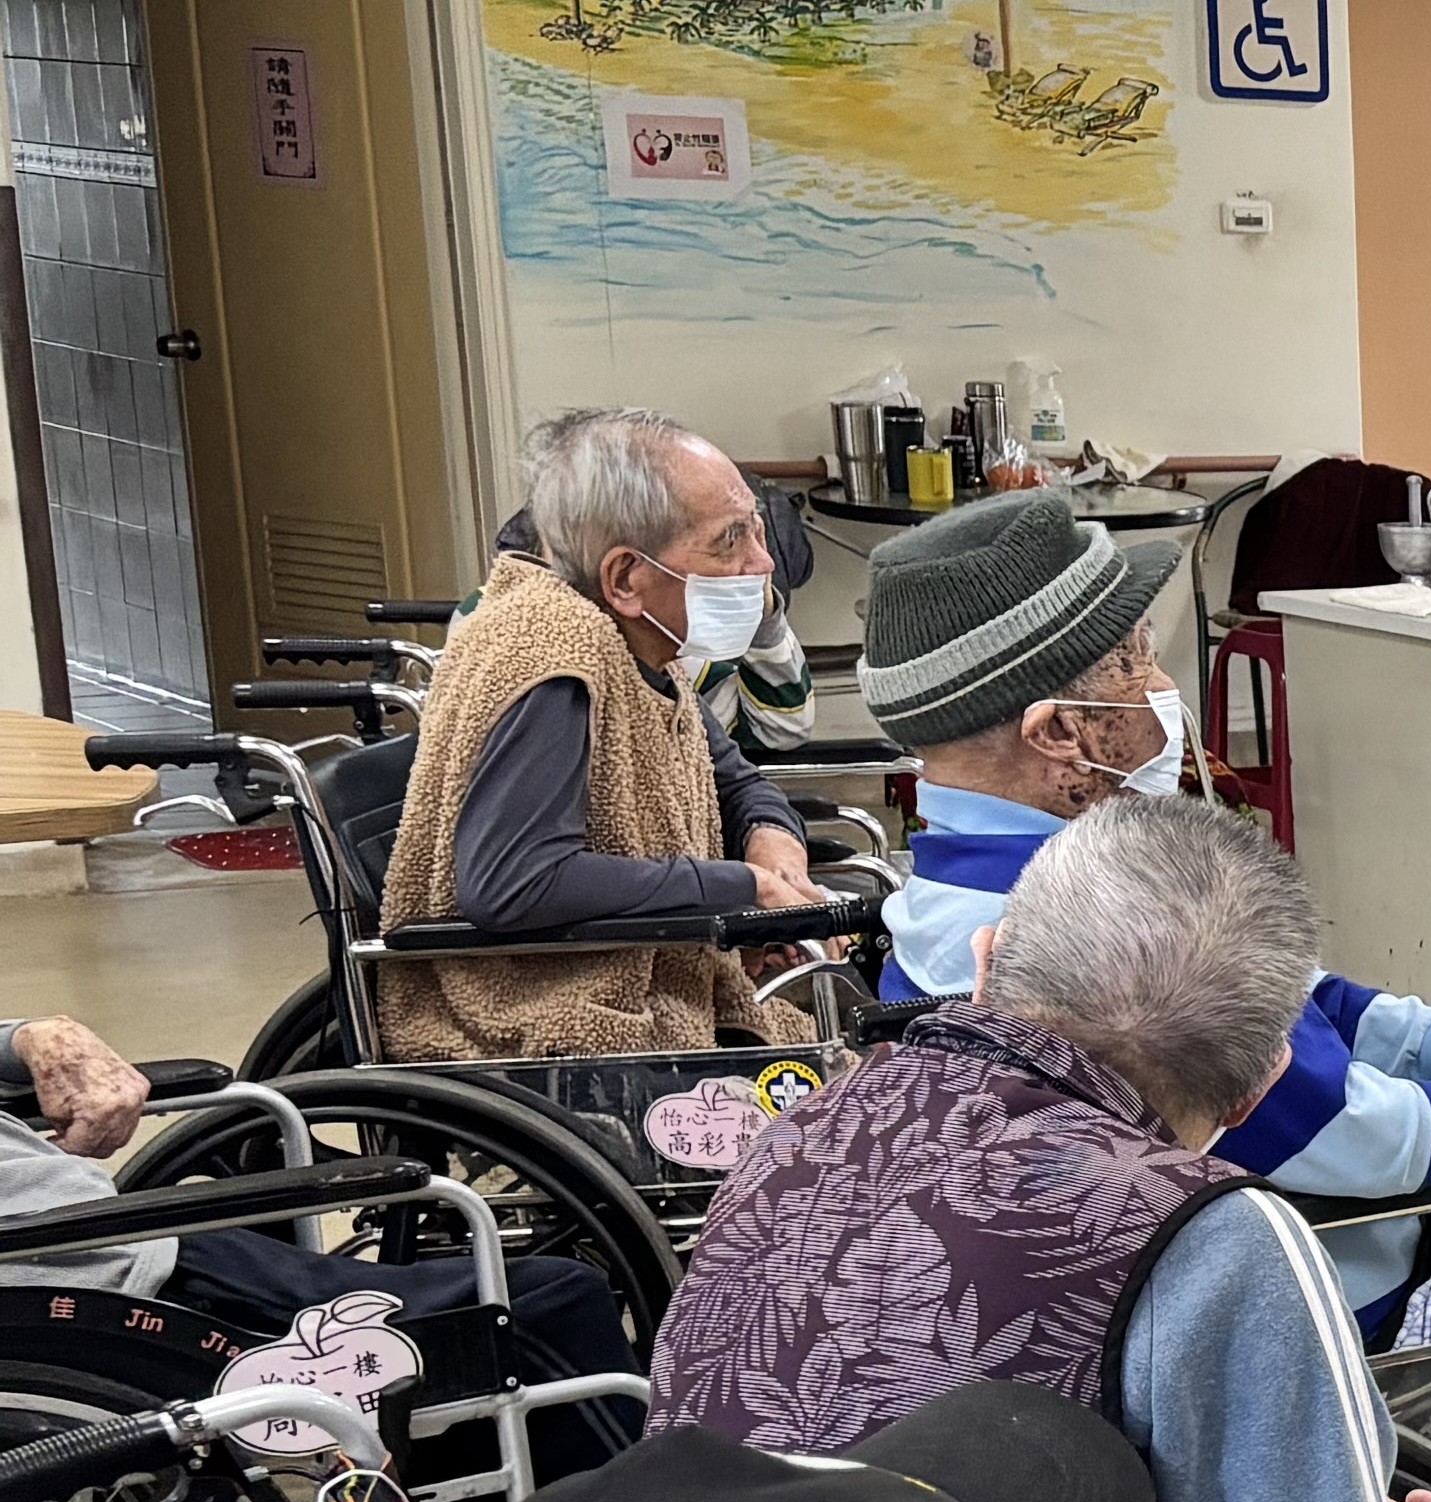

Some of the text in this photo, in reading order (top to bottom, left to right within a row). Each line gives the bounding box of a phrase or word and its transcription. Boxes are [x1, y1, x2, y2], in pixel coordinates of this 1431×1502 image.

[265, 57, 298, 158] 請隨手關門
[660, 1107, 763, 1132] 怡心一樓
[49, 1295, 76, 1320] 佳
[124, 1308, 164, 1333] Jin
[264, 1389, 383, 1442] 周田
